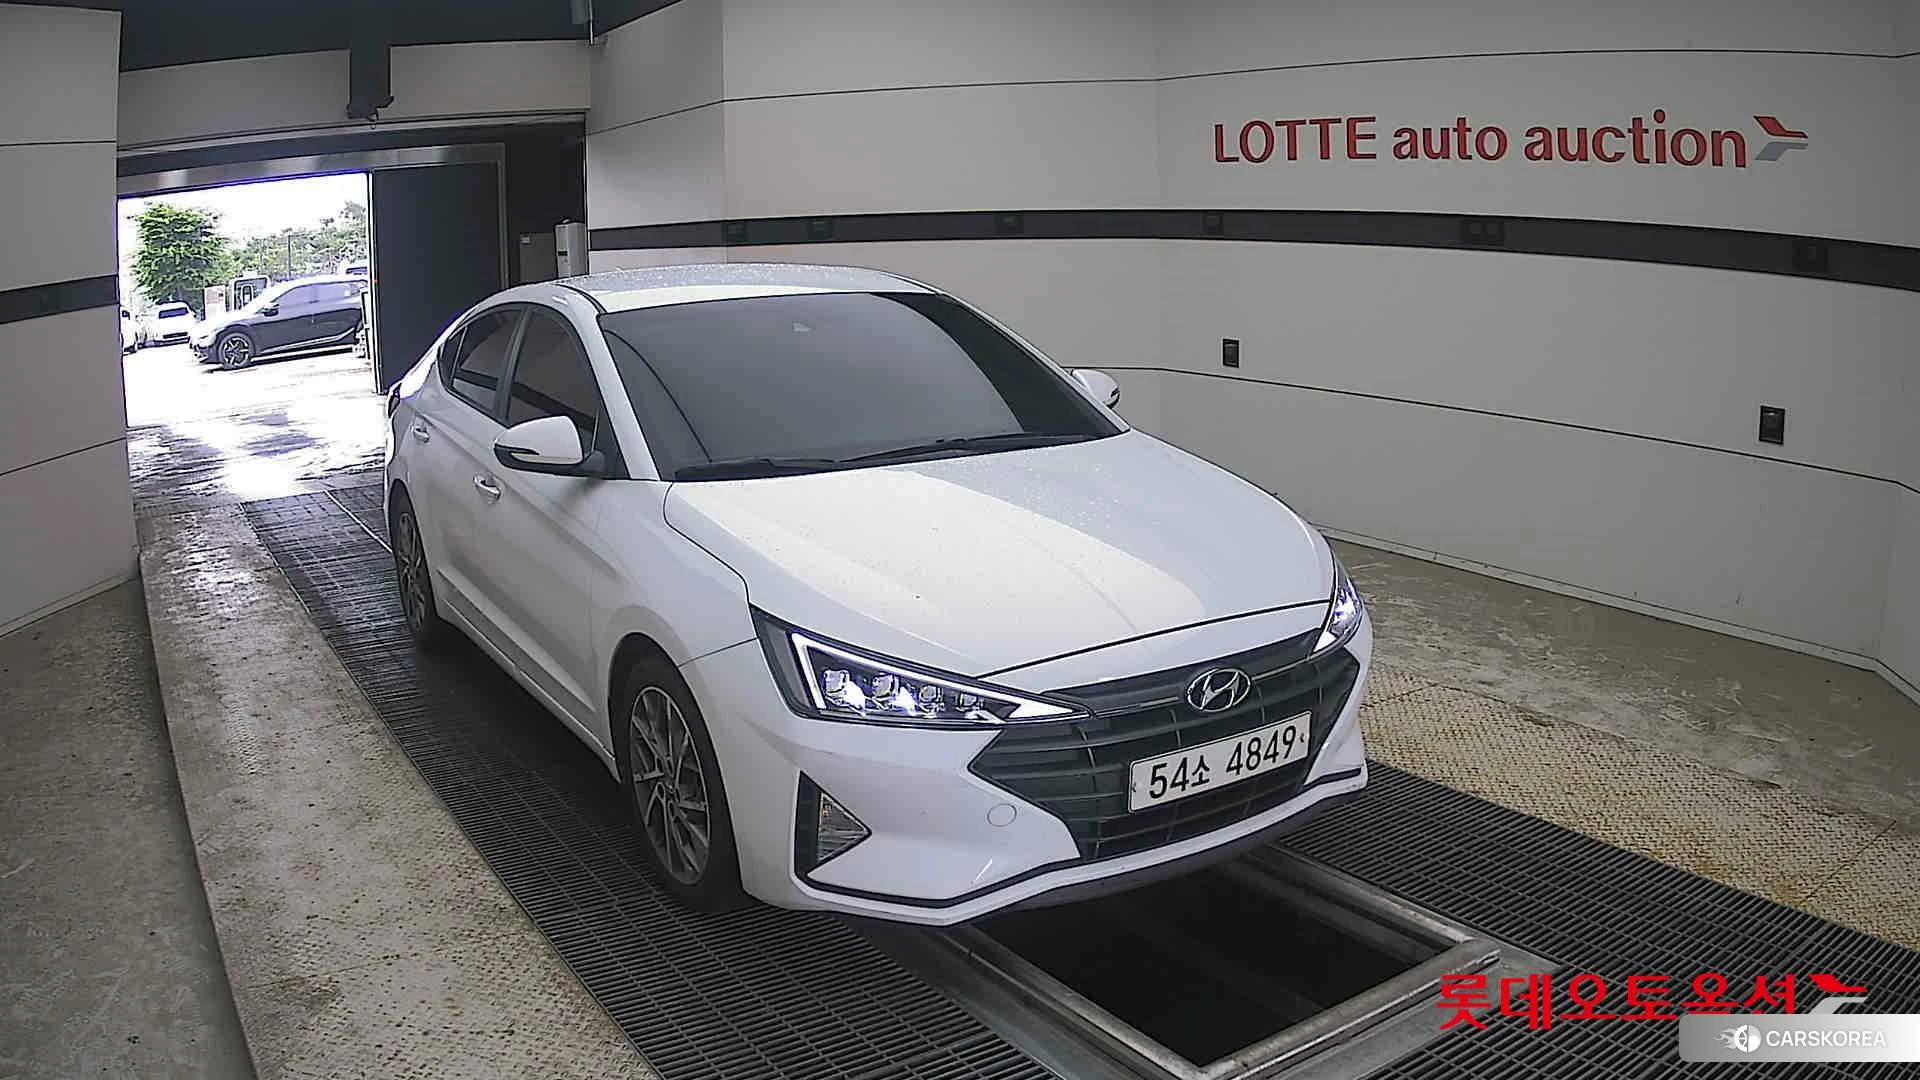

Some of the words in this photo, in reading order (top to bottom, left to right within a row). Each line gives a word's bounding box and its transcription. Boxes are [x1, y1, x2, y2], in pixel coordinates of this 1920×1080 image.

[1214, 116, 1377, 163] LOTTE
[1392, 117, 1508, 161] auto
[1523, 109, 1747, 168] auction
[1149, 755, 1210, 799] 54소
[1226, 725, 1297, 776] 4849
